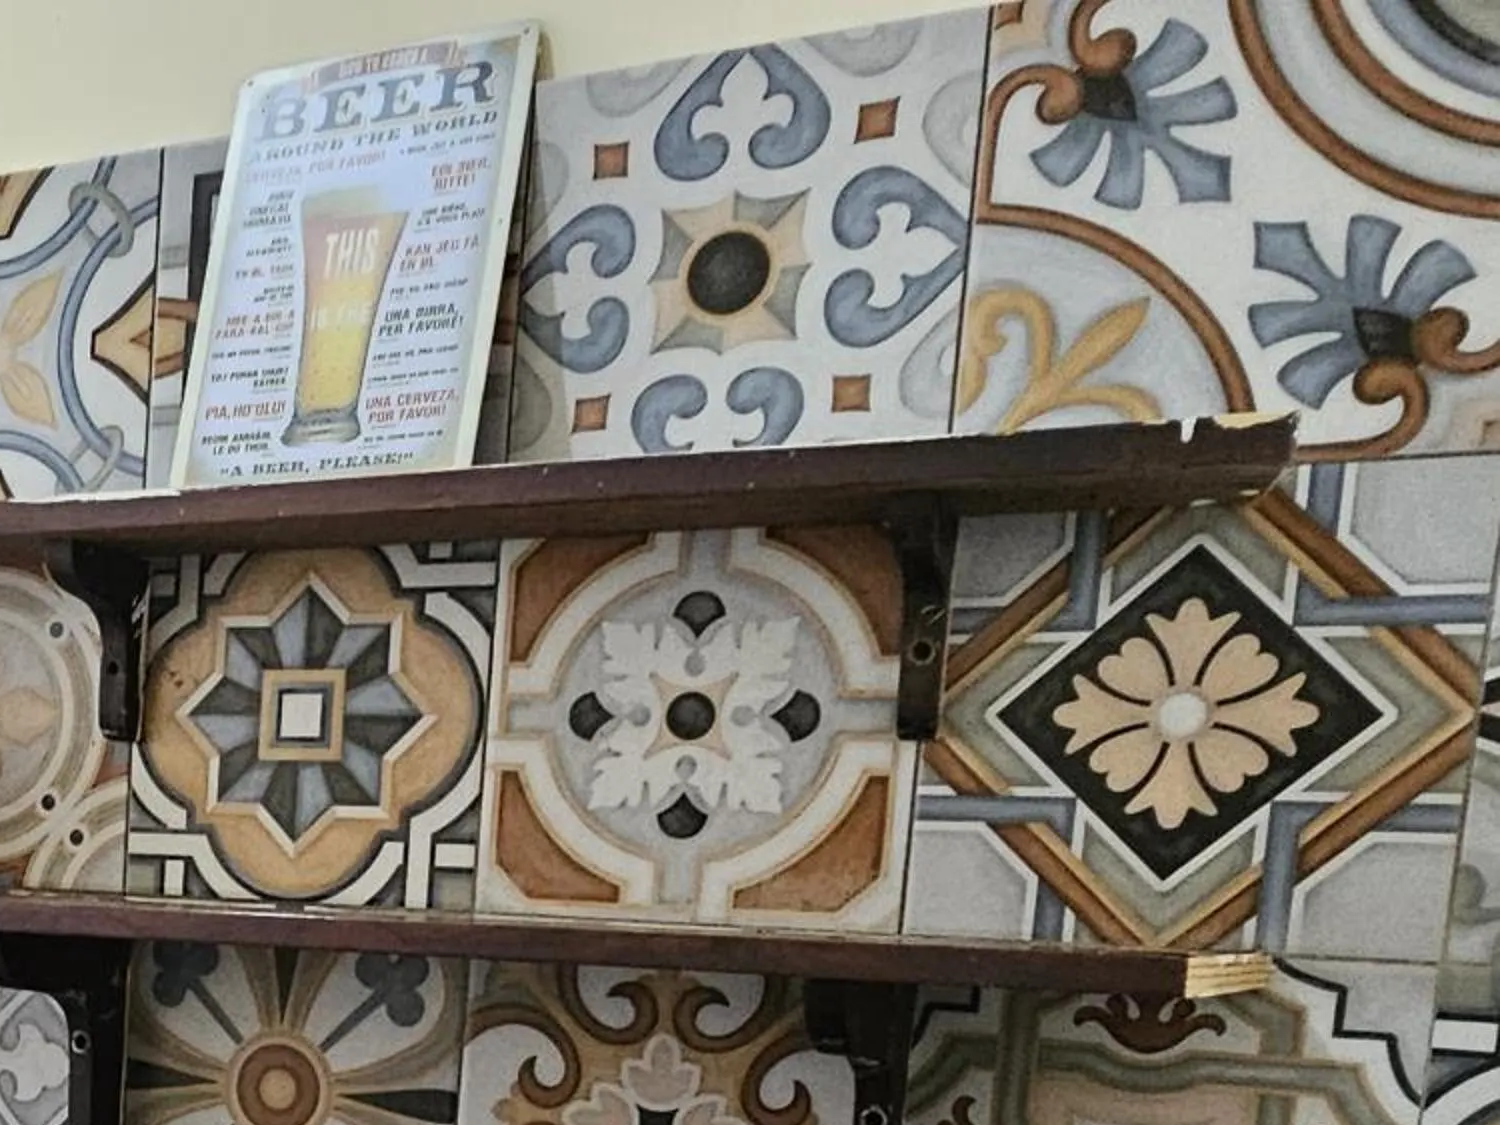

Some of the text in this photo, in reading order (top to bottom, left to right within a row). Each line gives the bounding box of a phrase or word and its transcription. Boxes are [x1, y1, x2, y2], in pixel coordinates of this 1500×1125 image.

[256, 61, 497, 140] BEER
[250, 138, 344, 163] AROUND
[353, 128, 401, 147] THE
[412, 111, 498, 137] WORLD
[323, 228, 380, 280] THIS
[384, 308, 410, 323] UNA
[379, 323, 403, 337] PER
[366, 396, 391, 410] UNA
[368, 404, 447, 424] POR FAVOR!
[253, 461, 310, 475] BEER,
